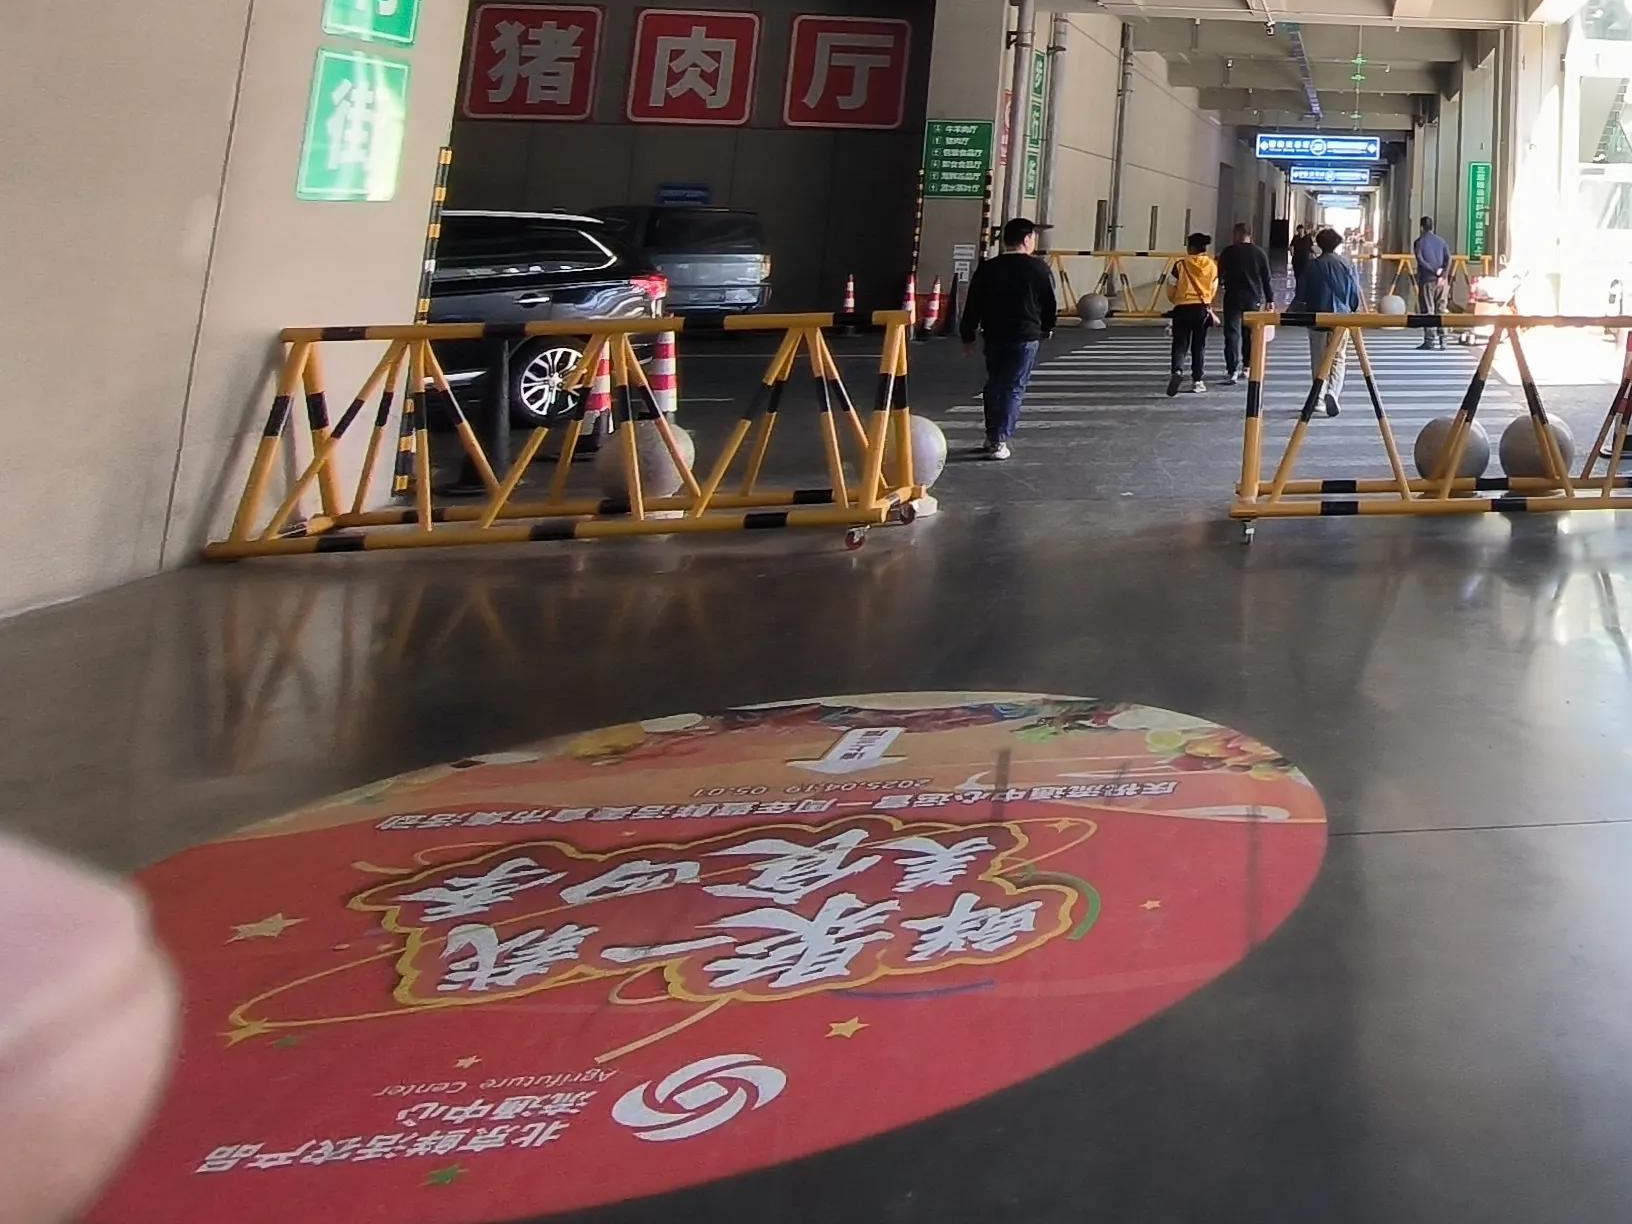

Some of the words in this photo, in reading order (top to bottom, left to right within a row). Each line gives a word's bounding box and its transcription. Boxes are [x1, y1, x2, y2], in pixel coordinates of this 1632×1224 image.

[486, 17, 895, 111] 猪肉厅
[395, 828, 997, 923] 美食四季
[437, 891, 1043, 991] 鲜聚一载
[372, 1080, 469, 1099] Center
[478, 1066, 618, 1093] Agrifuture
[394, 1088, 597, 1127] 流通中心
[192, 1120, 570, 1175] 北京鲜活农产品
